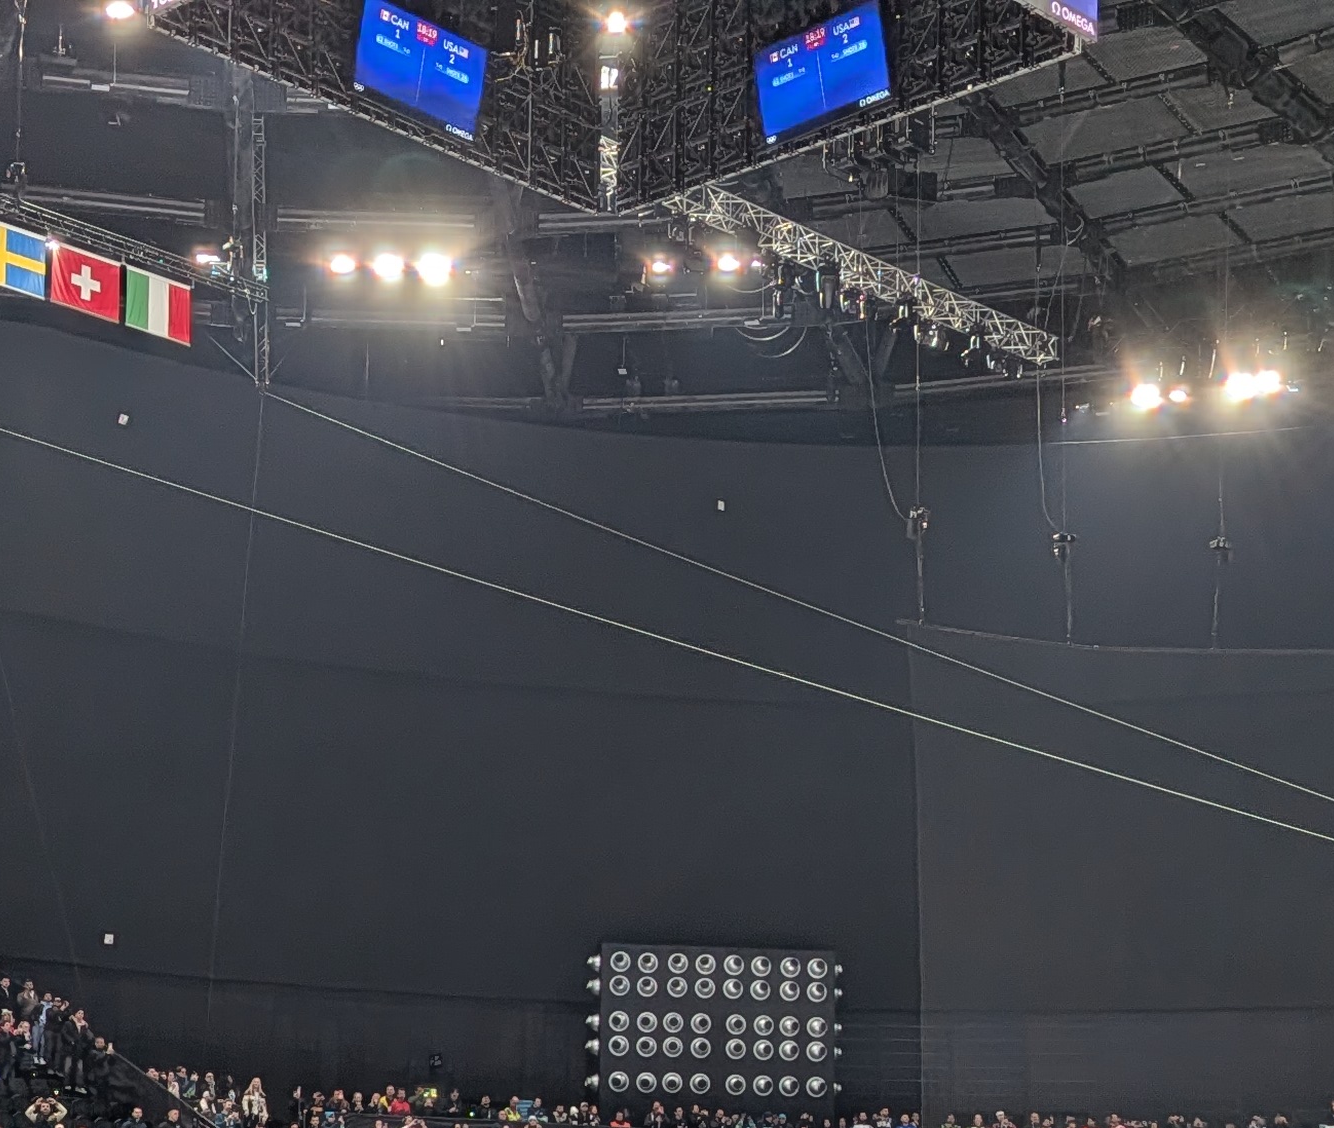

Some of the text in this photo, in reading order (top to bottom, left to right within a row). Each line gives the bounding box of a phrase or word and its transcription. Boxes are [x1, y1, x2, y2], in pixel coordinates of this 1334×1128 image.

[390, 14, 410, 31] CAN
[1061, 6, 1095, 36] OMEGA
[395, 29, 400, 39] 1
[833, 22, 849, 36] USA
[443, 38, 459, 54] USA
[779, 43, 798, 59] CAN
[448, 54, 455, 64] 2
[787, 58, 793, 68] 1
